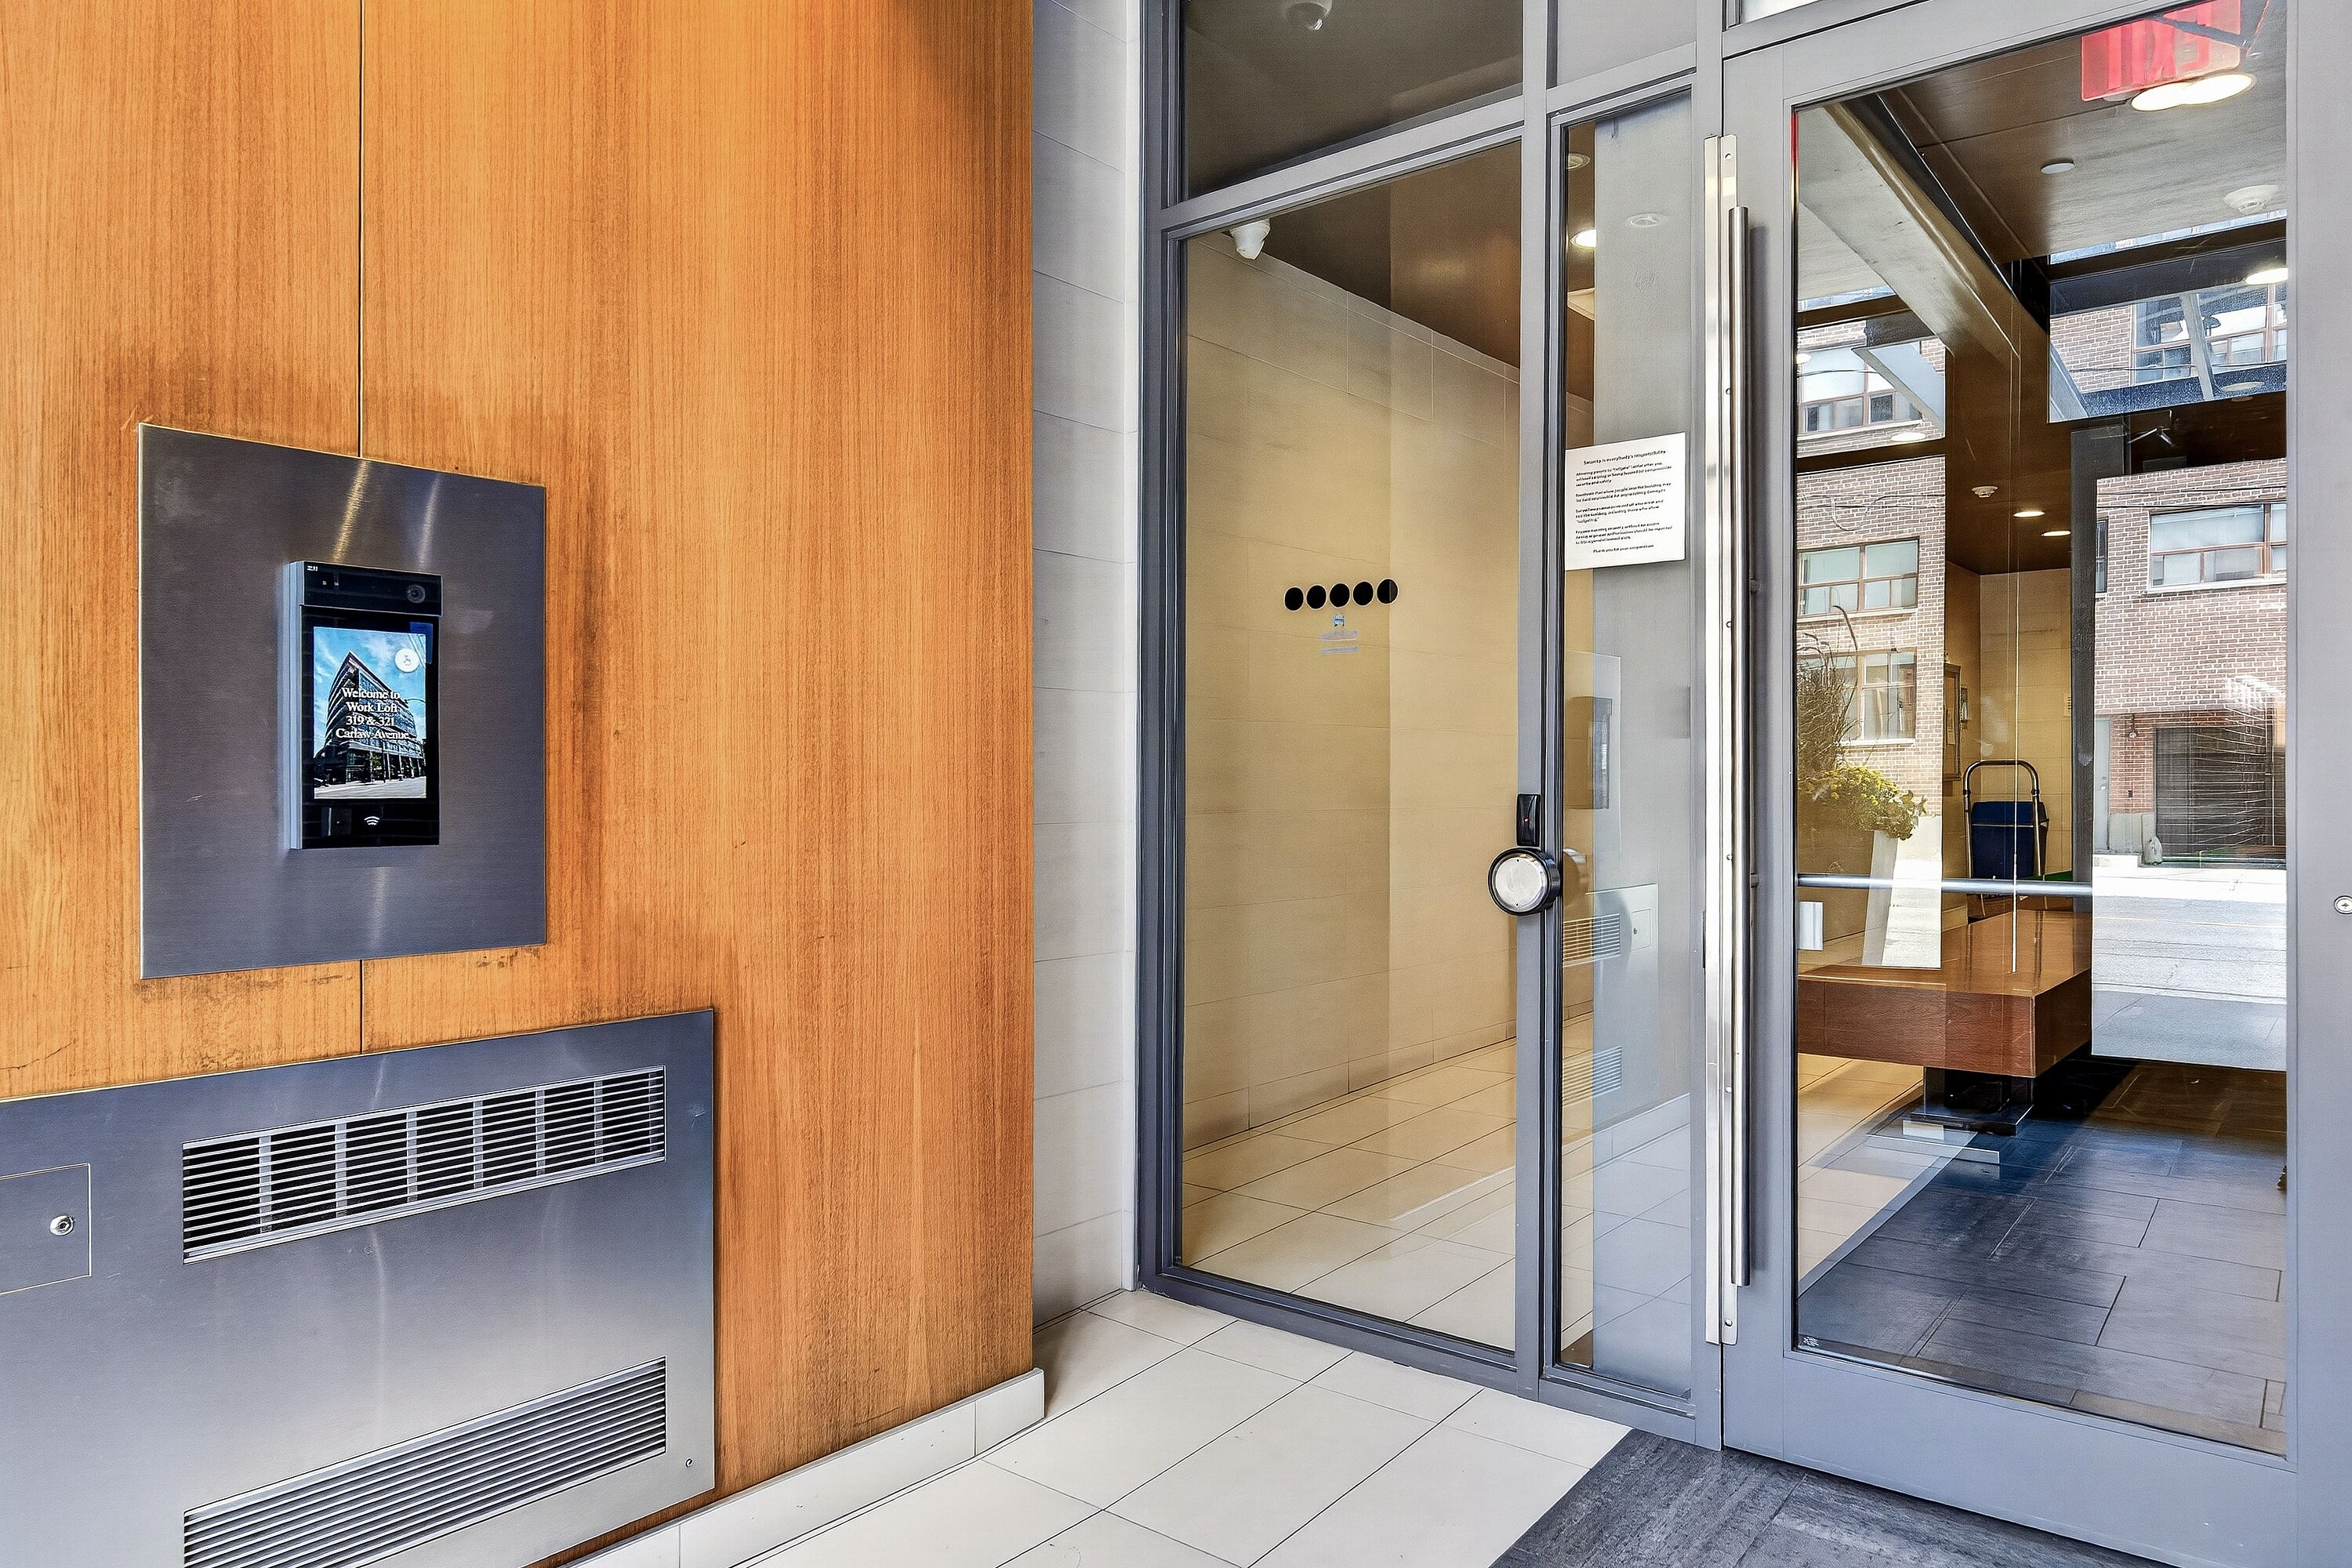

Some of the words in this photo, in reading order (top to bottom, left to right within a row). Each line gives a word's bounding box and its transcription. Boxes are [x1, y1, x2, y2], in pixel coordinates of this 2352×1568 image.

[341, 687, 389, 699] Welcome
[346, 701, 374, 713] Work
[377, 702, 397, 713] Loft
[346, 715, 364, 725] 319
[366, 717, 376, 726] &
[379, 717, 394, 727] 321
[374, 730, 409, 739] Avenue
